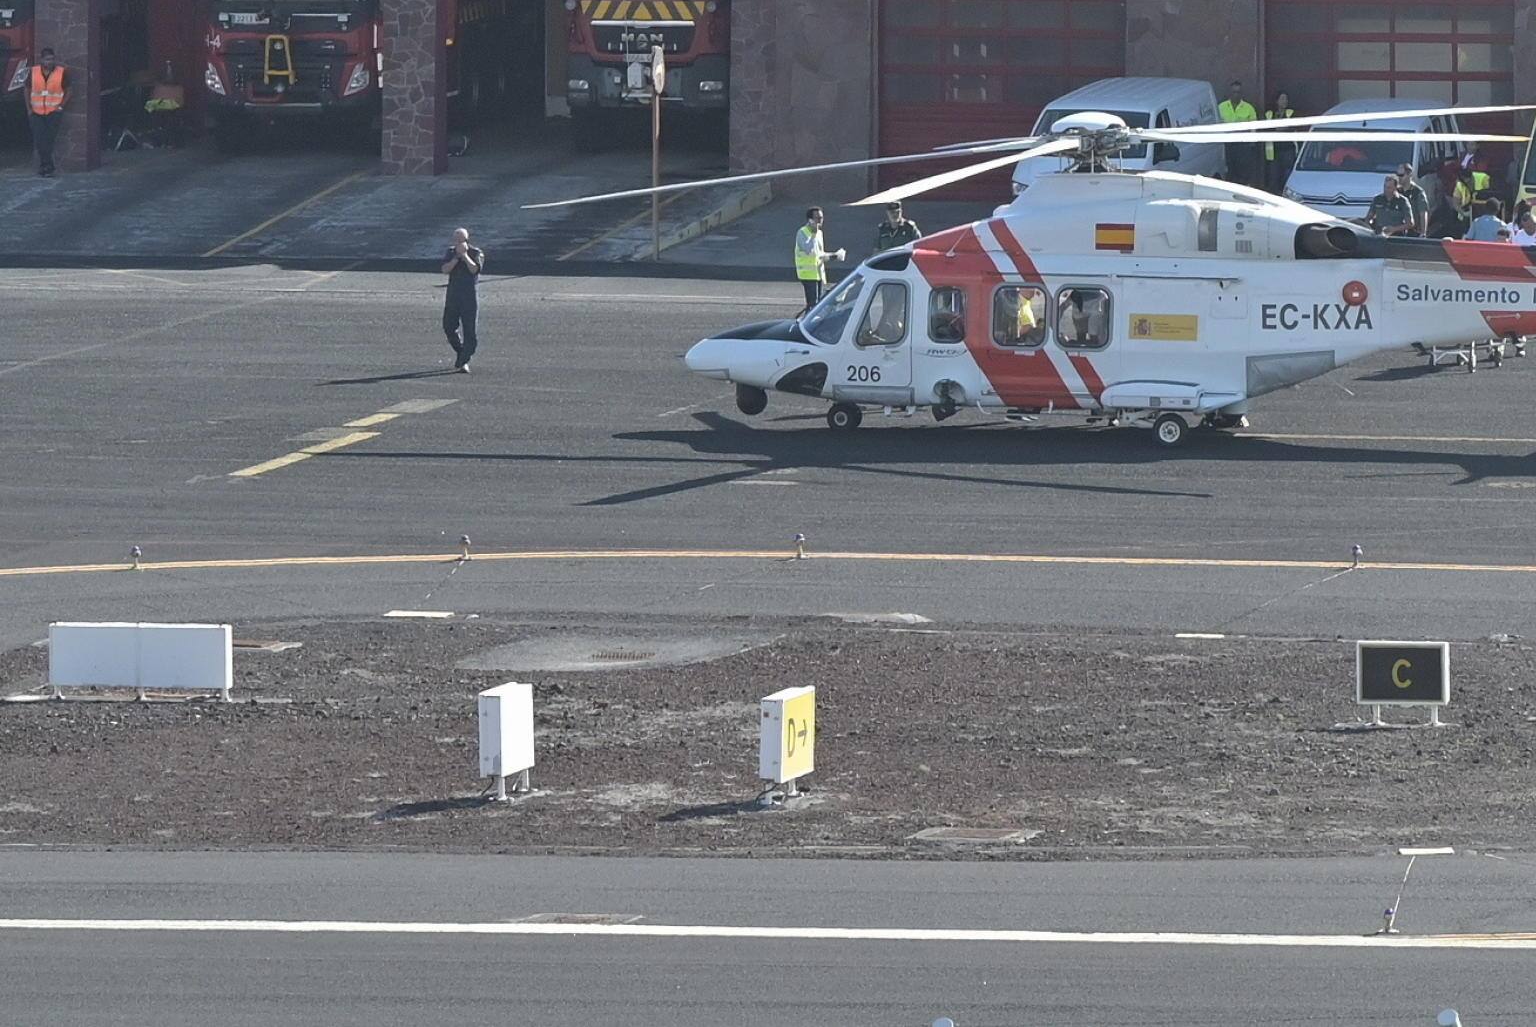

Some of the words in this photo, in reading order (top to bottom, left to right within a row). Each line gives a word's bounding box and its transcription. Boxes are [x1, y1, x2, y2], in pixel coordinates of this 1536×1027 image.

[621, 33, 664, 42] MAN
[1397, 284, 1521, 304] Salvamento
[1261, 303, 1373, 330] EC-KXA
[847, 365, 881, 382] 206
[1392, 658, 1411, 688] C
[788, 717, 796, 759] D
